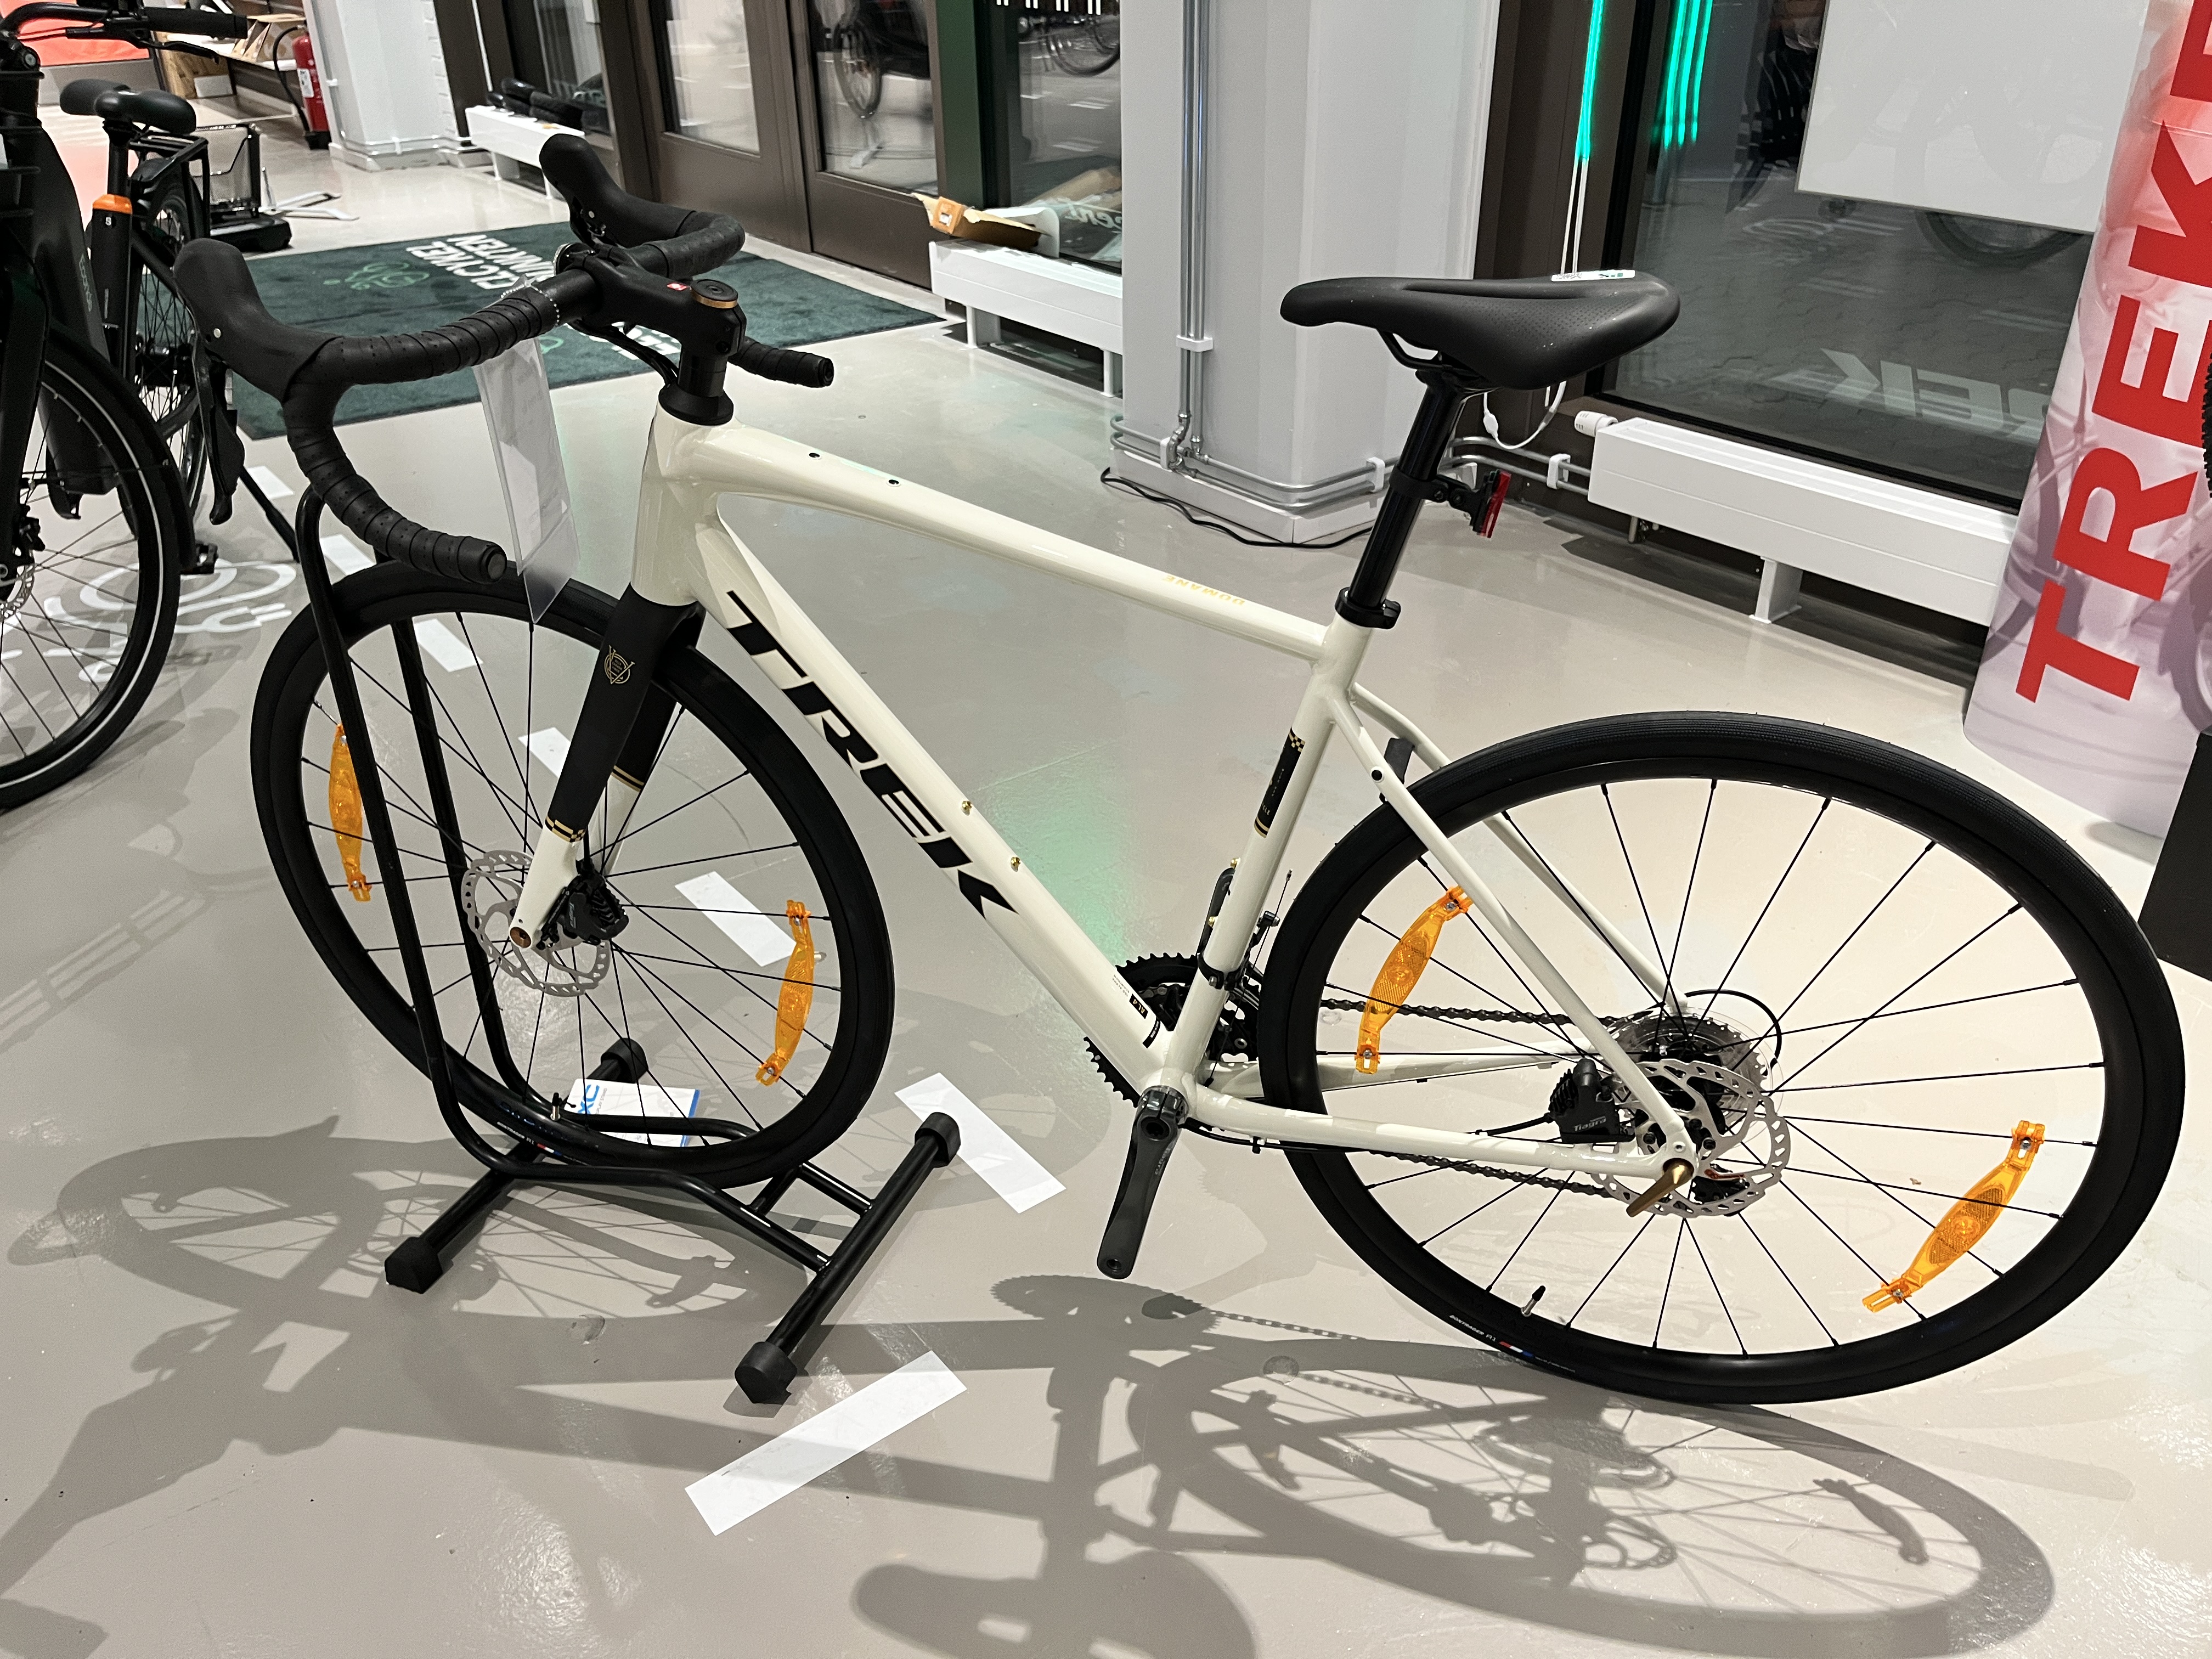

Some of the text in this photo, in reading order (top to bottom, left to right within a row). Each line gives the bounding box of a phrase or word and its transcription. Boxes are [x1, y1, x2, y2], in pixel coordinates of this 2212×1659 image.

[1163, 573, 1245, 606] DOMANE
[726, 589, 1019, 920] TREK
[1573, 1119, 1607, 1132] Tiagra
[1486, 1334, 1497, 1342] R1
